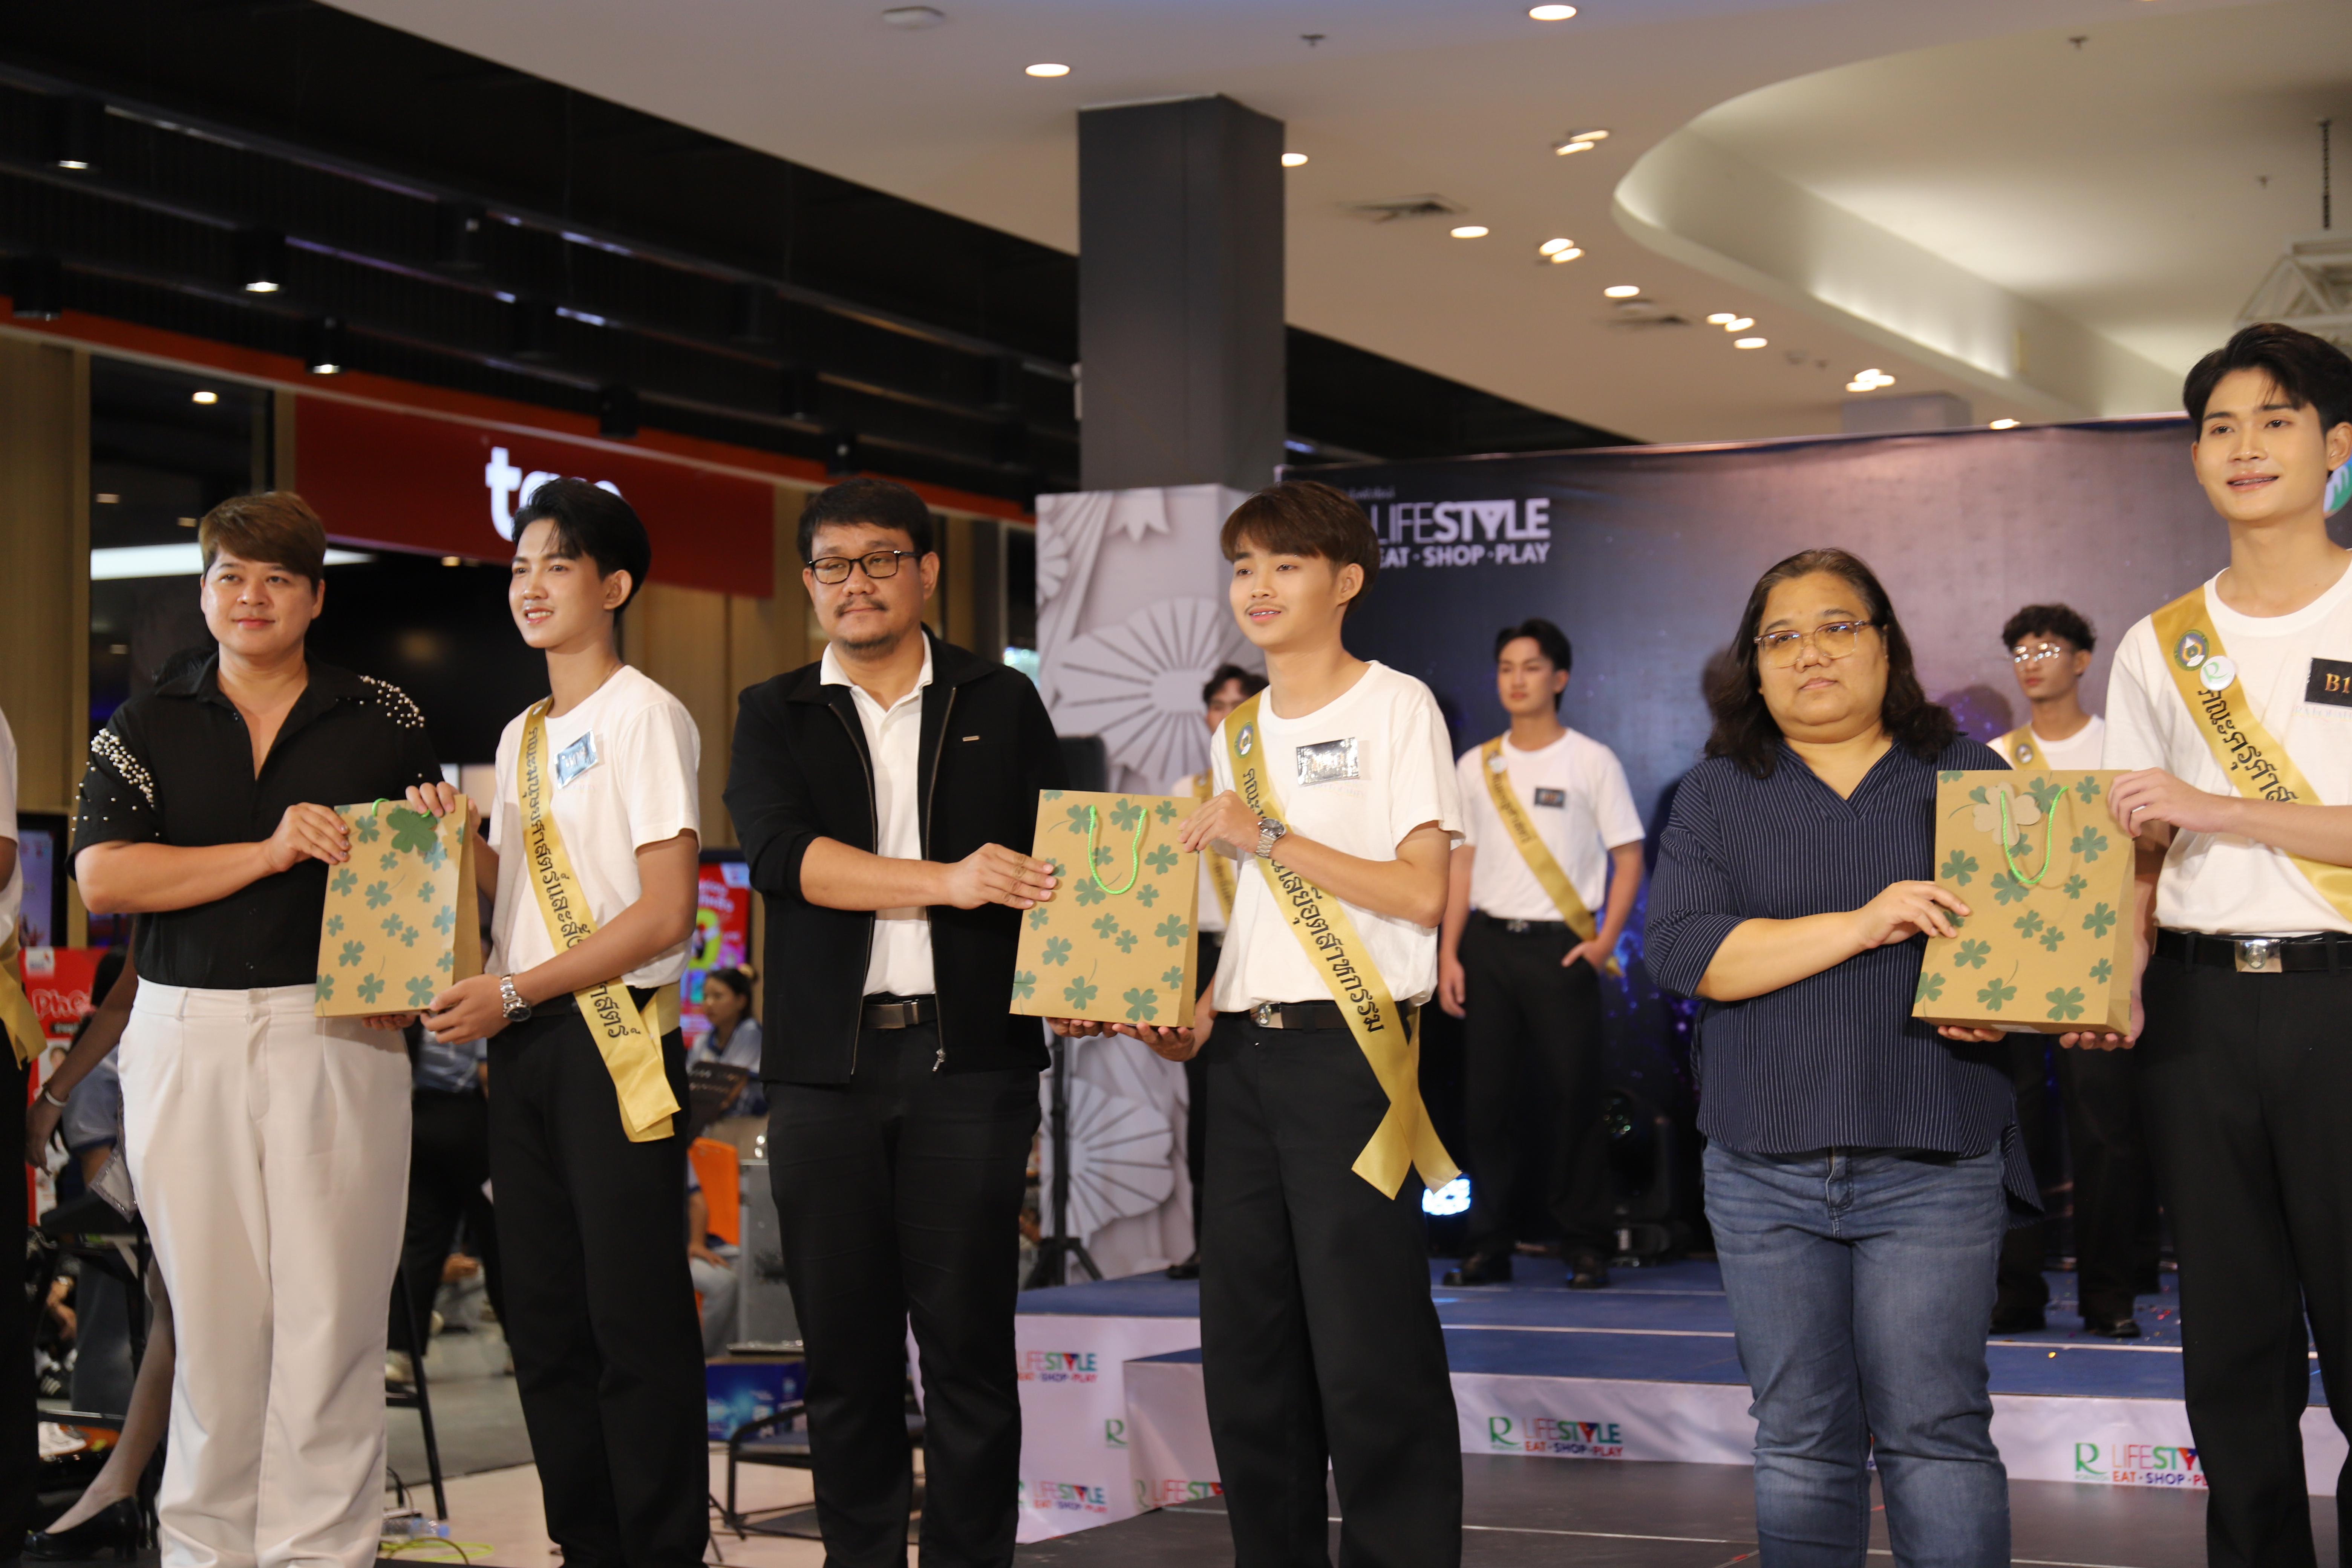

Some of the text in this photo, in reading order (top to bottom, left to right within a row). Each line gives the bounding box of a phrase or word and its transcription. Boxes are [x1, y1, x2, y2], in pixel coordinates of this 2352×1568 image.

[1371, 498, 1550, 544] LIFESTYLE
[1423, 545, 1485, 567] SHOP
[1496, 542, 1550, 565] PLAY
[2324, 673, 2352, 694] B1
[1522, 1418, 1622, 1444] LIFESTYLE
[1526, 1441, 1546, 1452] EAT
[1554, 1442, 1587, 1454] SHOP
[1593, 1446, 1623, 1457] PLAY
[2112, 1444, 2202, 1470] LIFESTY
[2113, 1471, 2136, 1482] EAT
[2146, 1472, 2184, 1484] SHOP
[2194, 1474, 2208, 1486] PL
